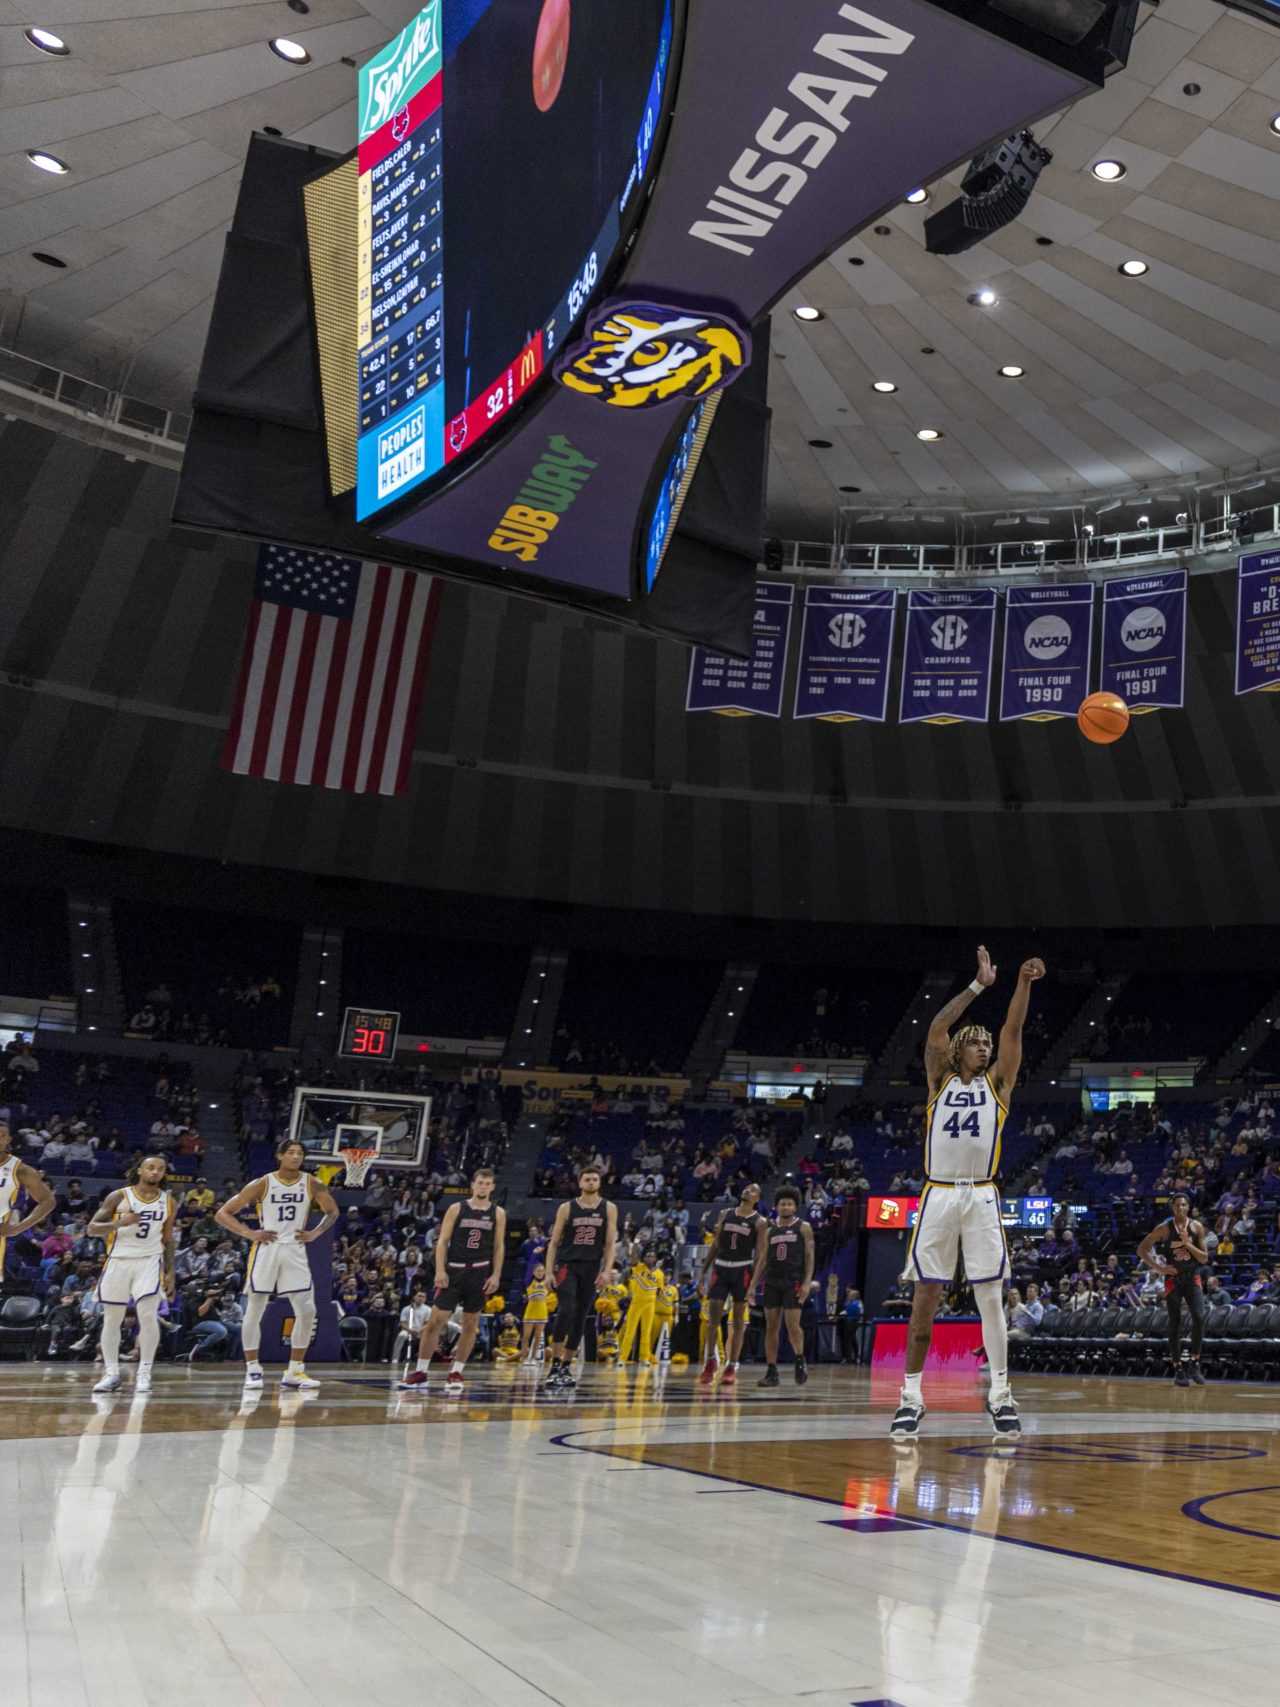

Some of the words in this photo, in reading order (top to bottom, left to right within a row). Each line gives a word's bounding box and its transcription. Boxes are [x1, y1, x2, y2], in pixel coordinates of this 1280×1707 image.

[370, 15, 432, 128] Sprite
[688, 3, 916, 256] NISSAN
[373, 140, 412, 182] FIELDS,CALEB
[383, 278, 393, 292] 15
[568, 251, 598, 322] 15:48
[406, 331, 415, 346] 17
[375, 380, 386, 395] 22
[408, 358, 415, 371] 5
[406, 385, 415, 399] 10
[486, 386, 504, 419] 32
[381, 414, 423, 460] PEOPLES
[382, 447, 422, 490] HEALTH
[488, 434, 599, 562] SUBWAY
[828, 612, 867, 649] SEC
[930, 614, 968, 651] SEC
[1125, 626, 1165, 642] NCAA
[1029, 635, 1070, 649] NCAA
[924, 656, 972, 664] CHAMPIONS
[1018, 676, 1044, 687] FINAL
[1047, 675, 1072, 686] FOUR
[1116, 670, 1141, 681] FINAL
[1143, 665, 1168, 677] FOUR
[1025, 687, 1063, 702] 1990
[1125, 679, 1157, 696] 1991
[352, 1028, 385, 1053] 30
[944, 1090, 987, 1107] LSU
[942, 1111, 980, 1138] 44
[270, 1194, 304, 1204] LSU
[1026, 1201, 1048, 1209] LSU
[139, 1210, 164, 1221] SU
[278, 1205, 296, 1222] 13
[1028, 1212, 1045, 1225] 40
[136, 1222, 149, 1239] 3
[466, 1229, 481, 1248] 2
[574, 1227, 596, 1245] 22
[730, 1232, 737, 1250] 1
[776, 1243, 787, 1260] 0
